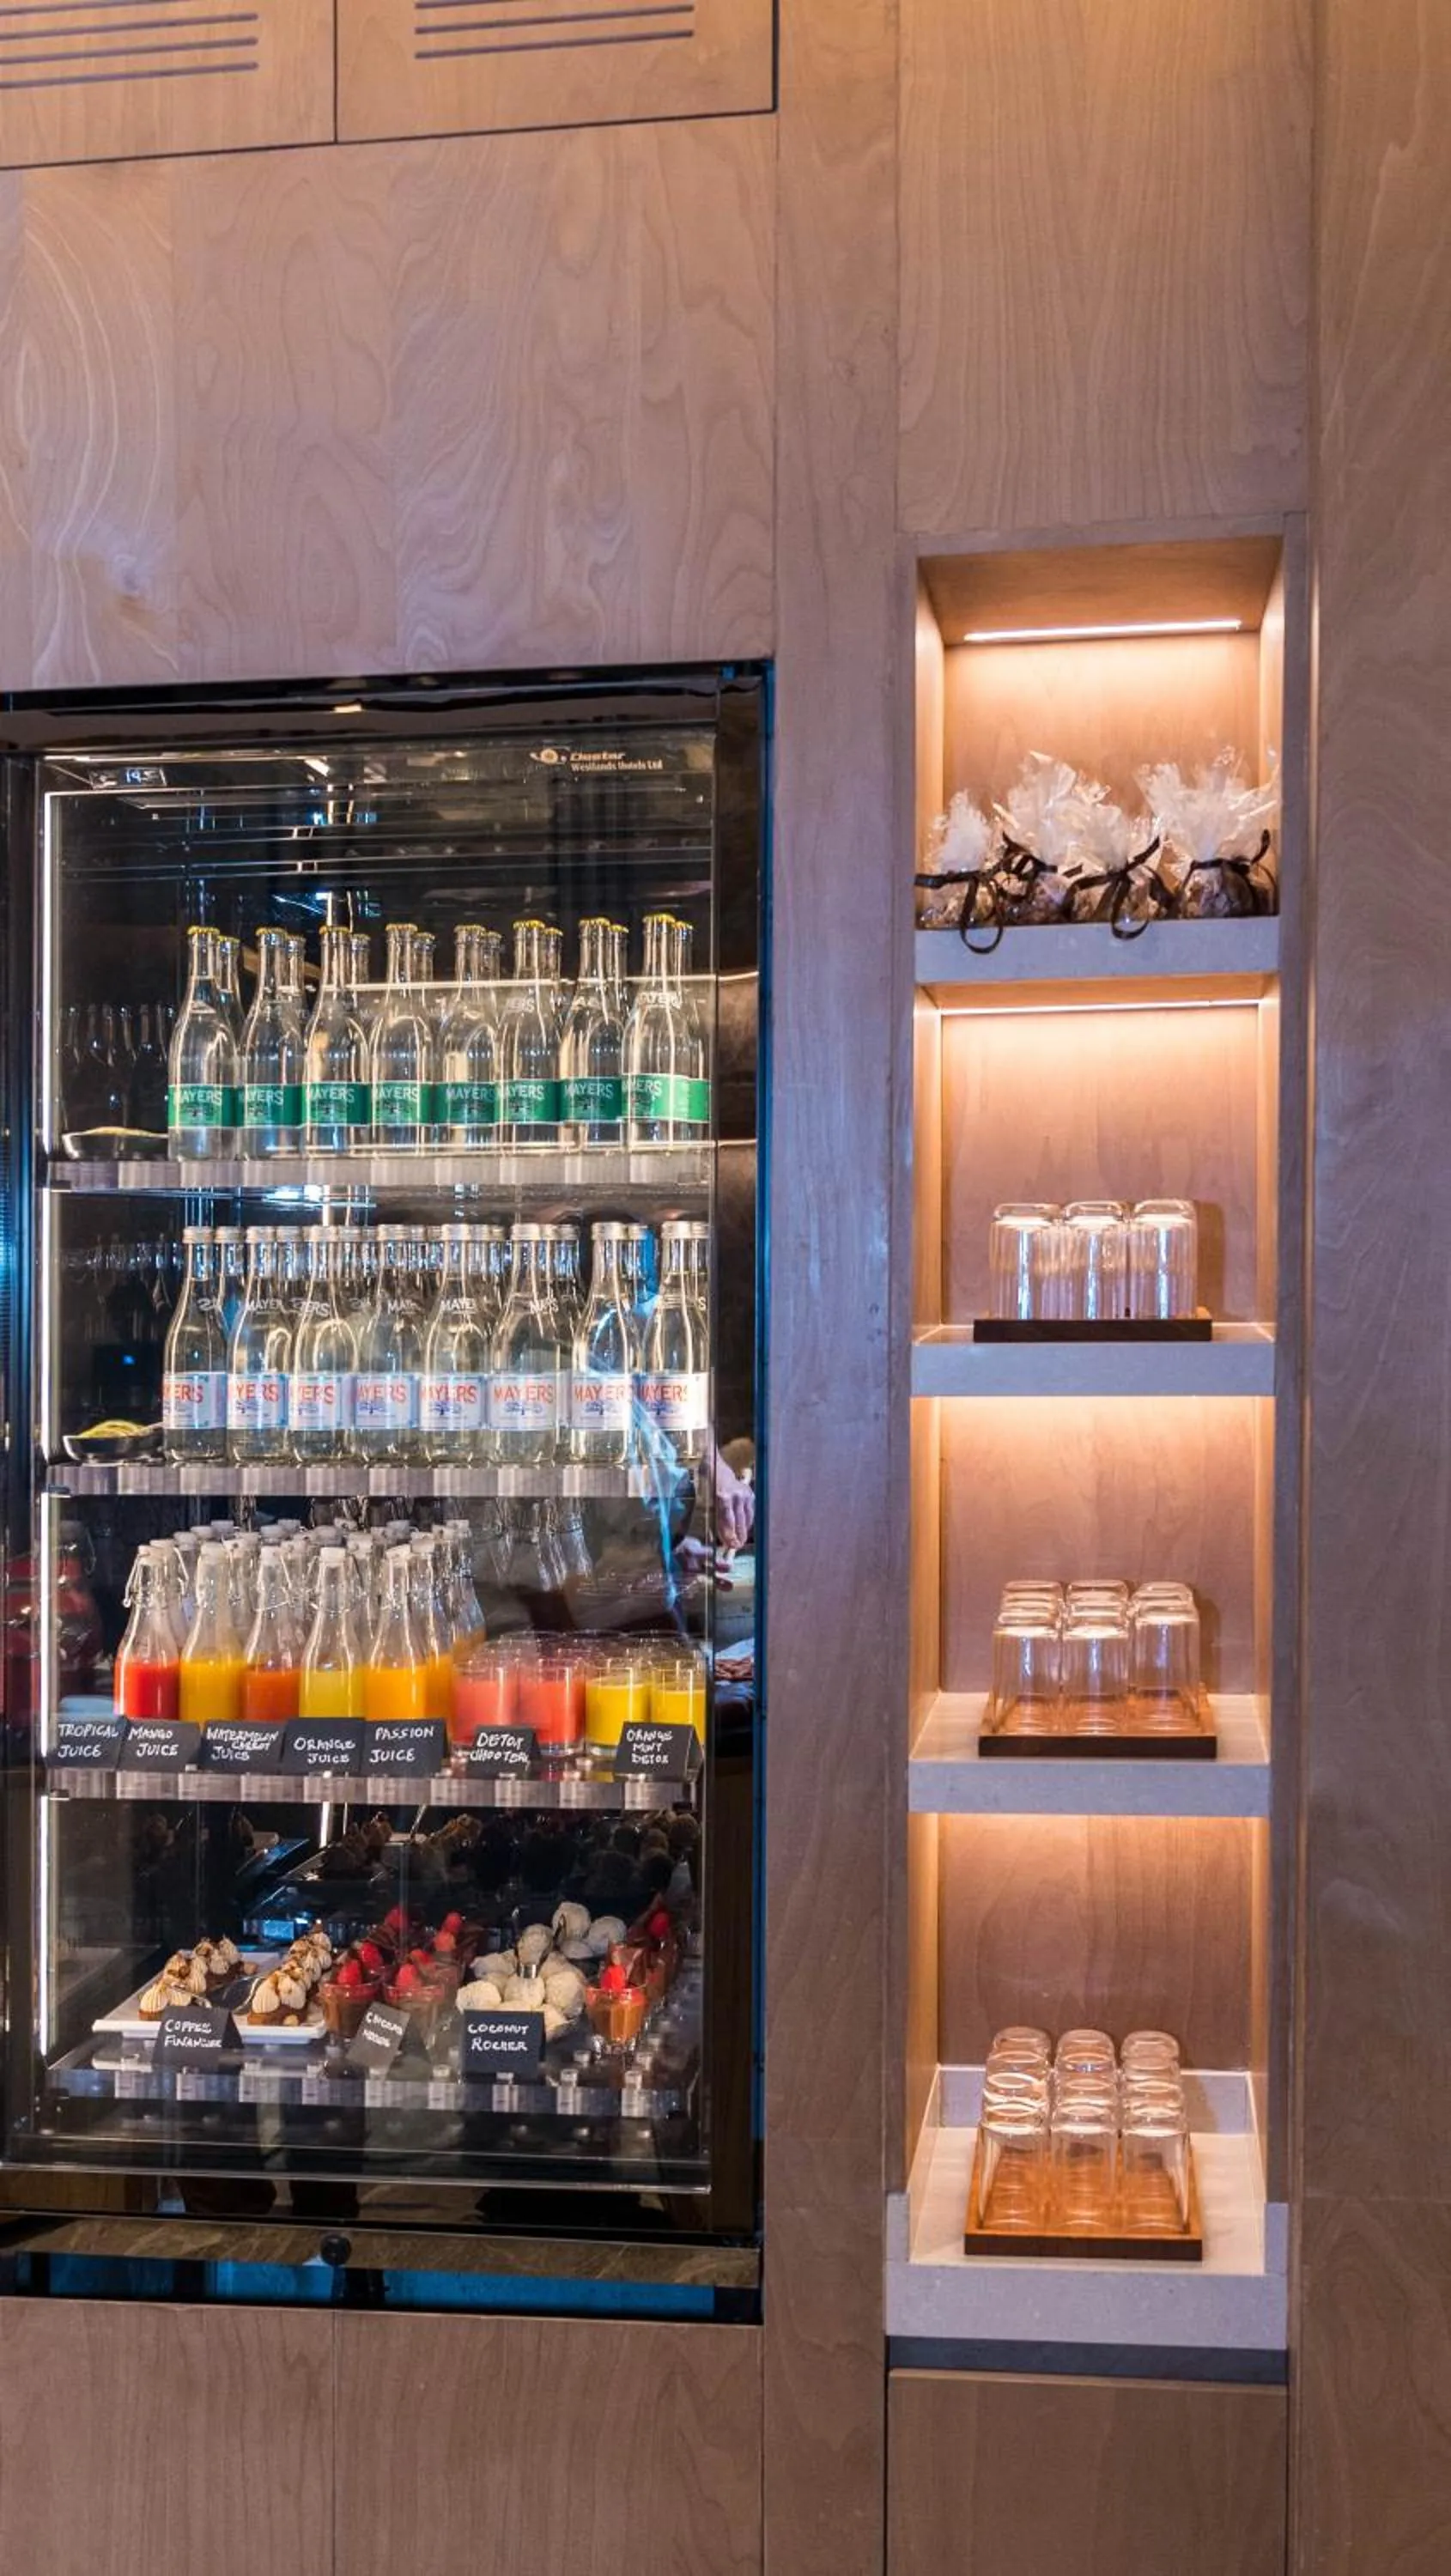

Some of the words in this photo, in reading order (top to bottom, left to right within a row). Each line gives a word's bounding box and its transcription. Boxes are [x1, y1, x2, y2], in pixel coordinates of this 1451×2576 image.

[494, 1383, 555, 1403] MAYERS
[58, 1723, 118, 1738] TROPICAL
[129, 1727, 173, 1740] MANGO
[375, 1726, 434, 1741] PASSION
[58, 1744, 101, 1758] JUICE
[137, 1744, 179, 1757] JUICE
[293, 1737, 356, 1751] ORANGE
[307, 1753, 350, 1765] JUICE
[369, 1748, 416, 1763] JUICE
[467, 2023, 530, 2036] COCONUT
[471, 2037, 528, 2051] ROCHER
